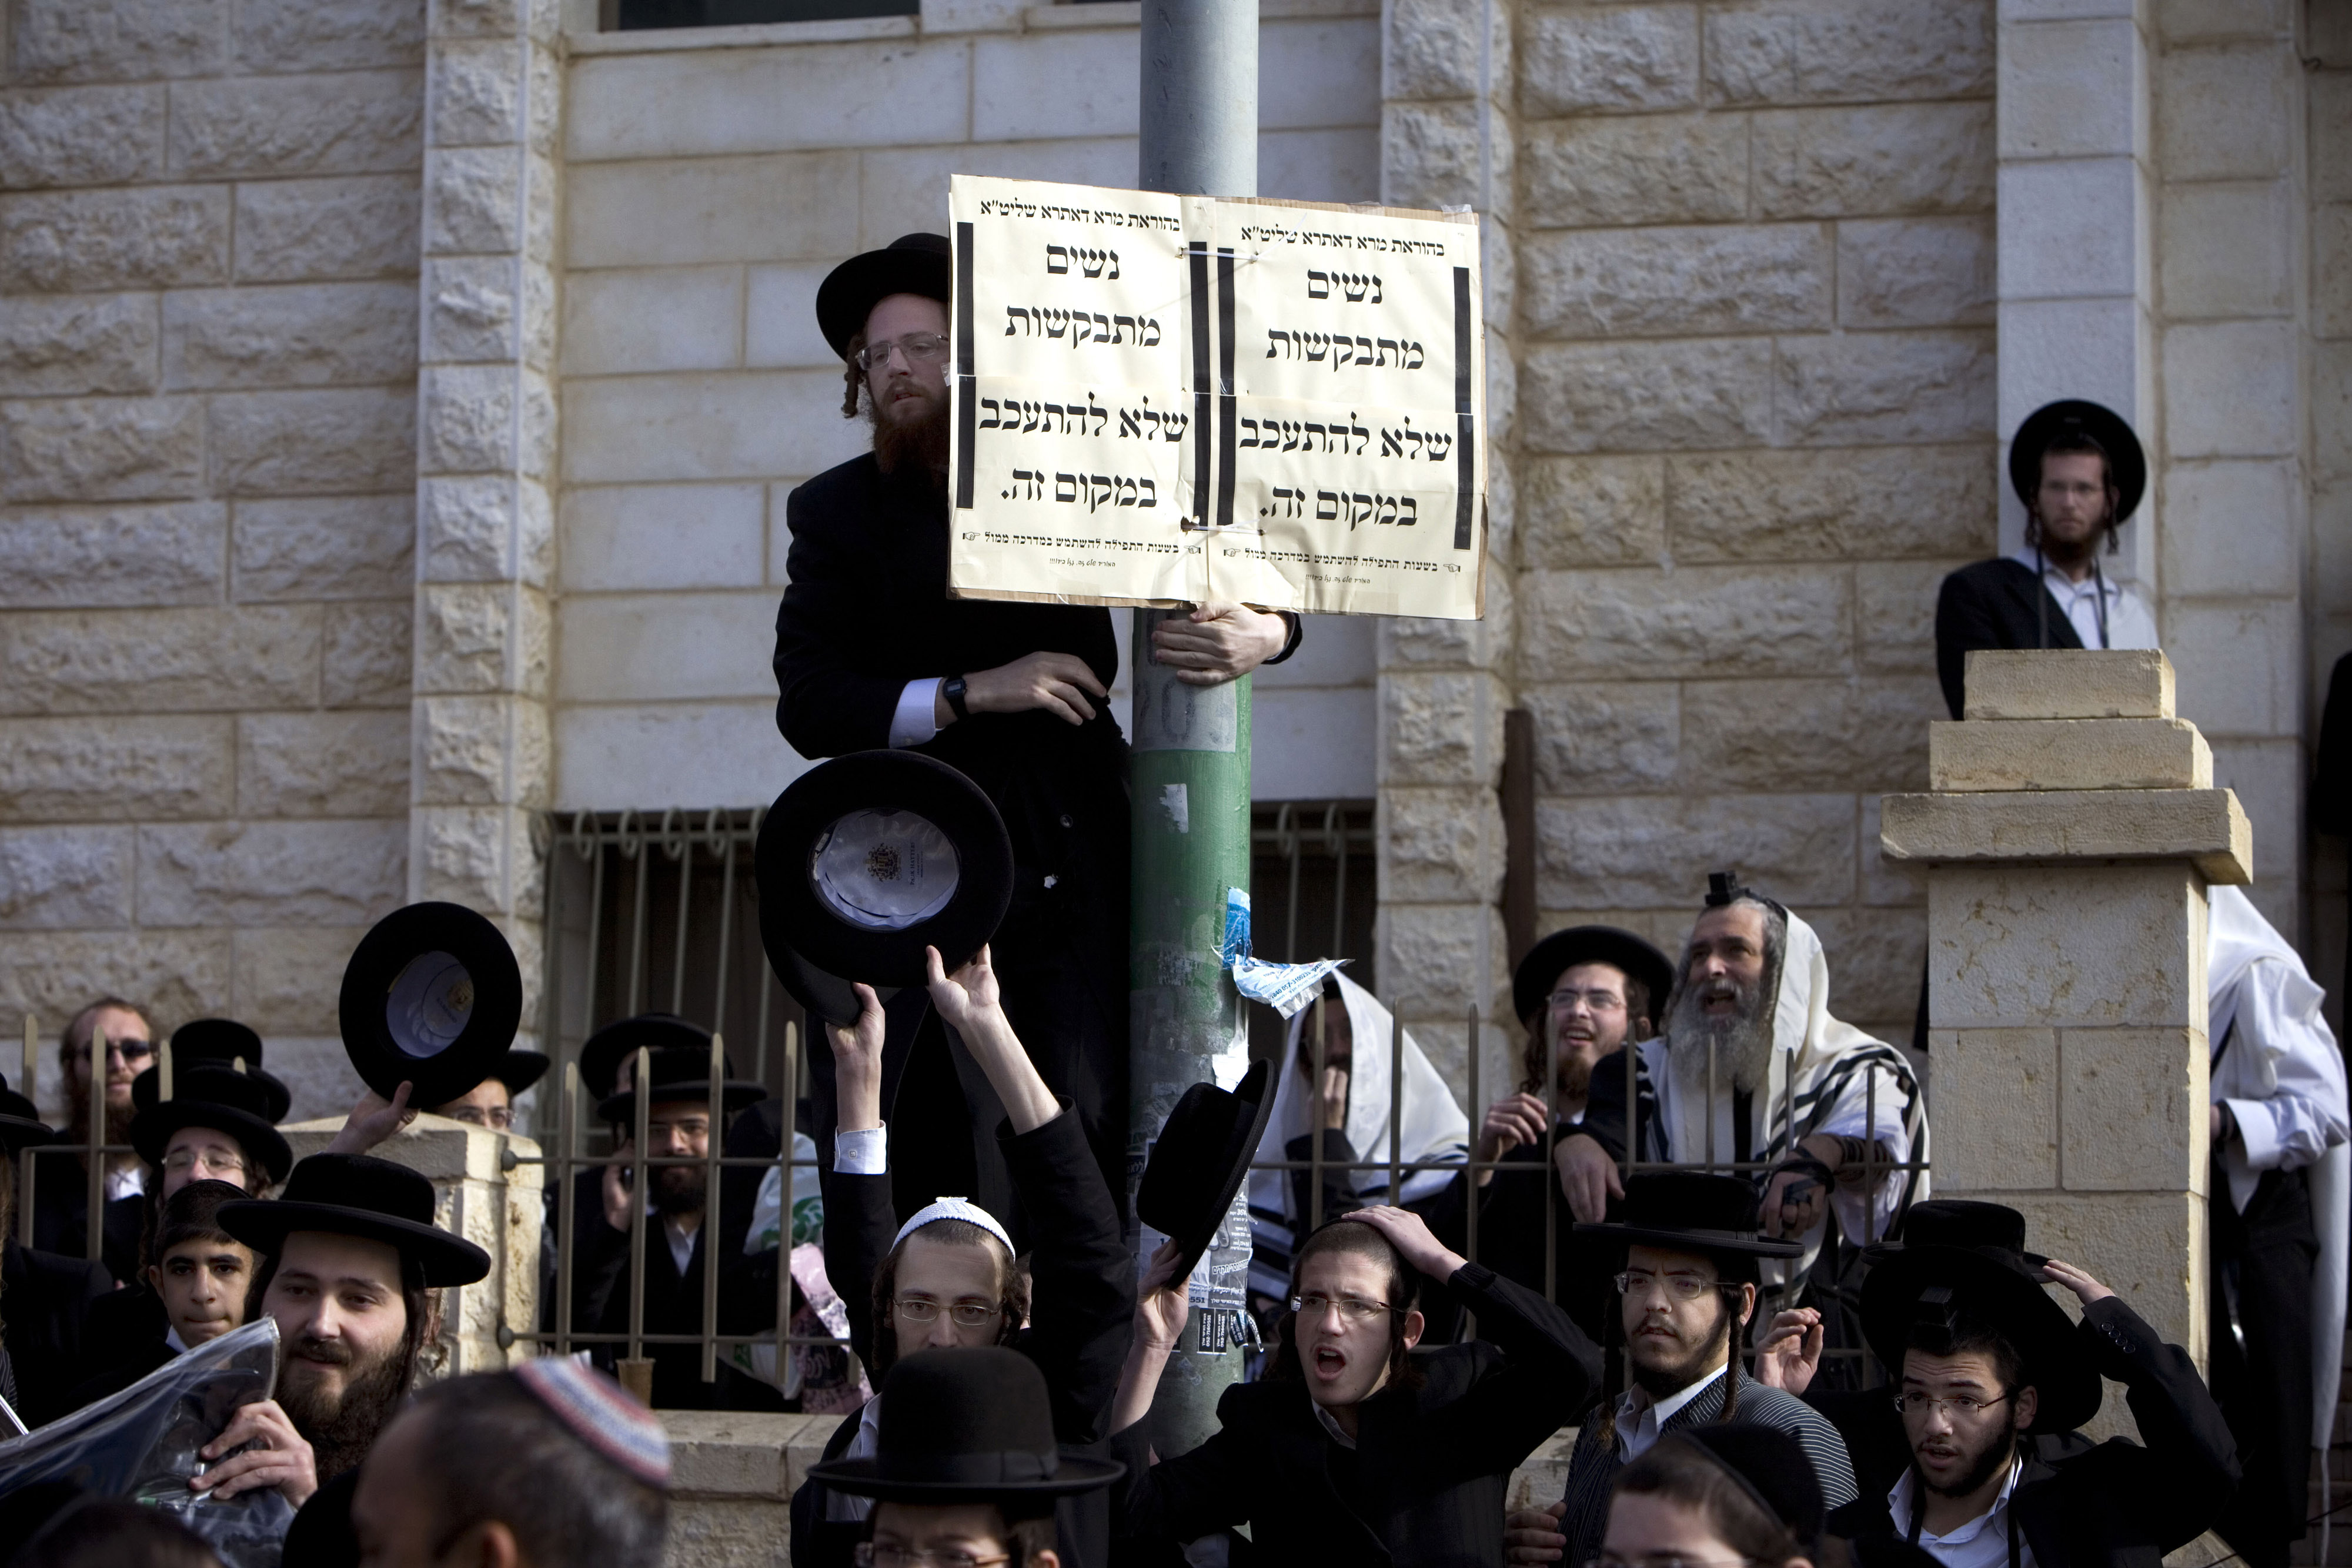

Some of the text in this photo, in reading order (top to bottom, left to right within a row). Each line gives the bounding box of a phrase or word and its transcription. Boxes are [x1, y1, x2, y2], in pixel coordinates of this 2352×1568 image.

[1041, 206, 1089, 223] דאתרא
[1094, 210, 1123, 226] מרא
[1128, 214, 1180, 231] בהוראת
[1302, 232, 1352, 248] דאתרא
[1357, 236, 1387, 250] מרא
[1392, 239, 1444, 256] בהוראת
[1047, 243, 1120, 280] נשים
[1308, 269, 1382, 303] נשים
[1005, 306, 1160, 349] מתבקשות
[1266, 329, 1424, 372] מתבקשות
[979, 391, 1188, 442] שלא להתעכב
[1240, 411, 1452, 462] שלא להתעכב
[1001, 468, 1157, 514] במקום זה.
[1260, 486, 1417, 531] במקום זה.
